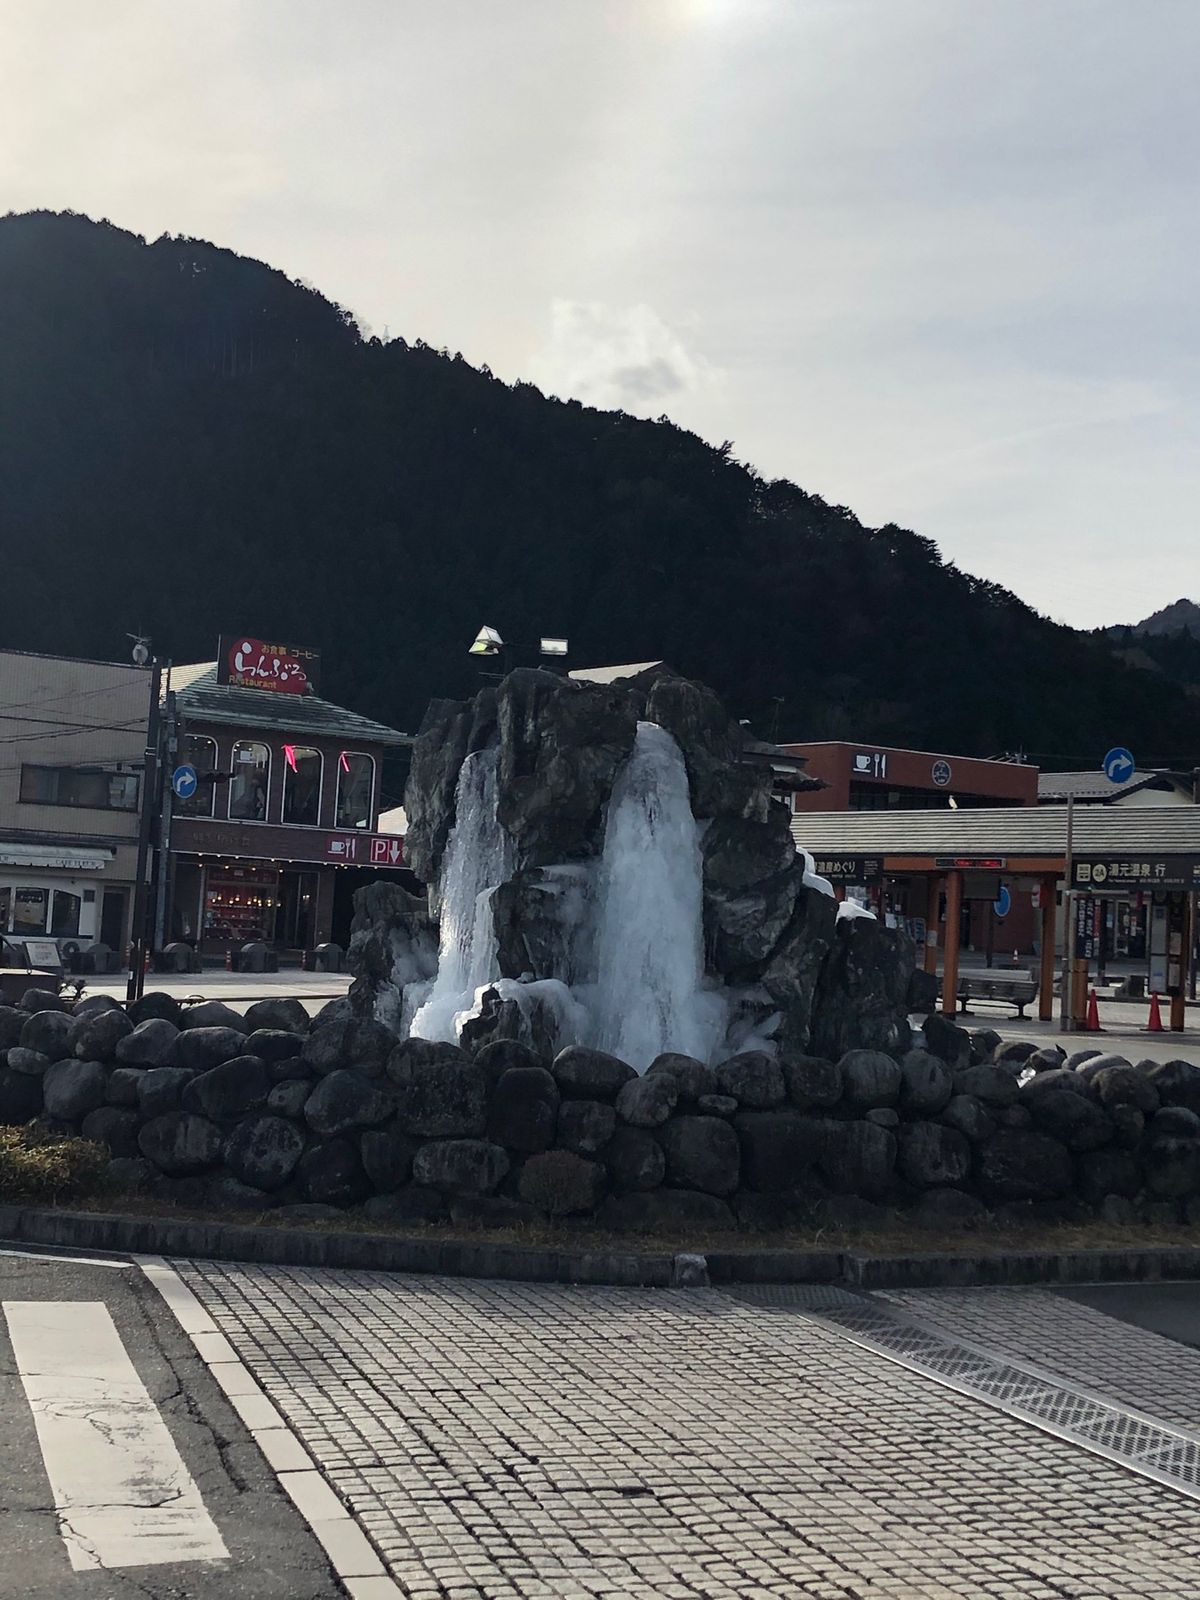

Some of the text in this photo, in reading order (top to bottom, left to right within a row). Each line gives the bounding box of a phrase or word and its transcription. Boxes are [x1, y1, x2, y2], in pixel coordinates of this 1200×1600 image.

[291, 649, 320, 660] コーヒー
[375, 841, 387, 861] P
[815, 861, 856, 873] 遺産めぐり
[1108, 864, 1151, 877] 湯元温泉
[1155, 864, 1166, 877] 行
